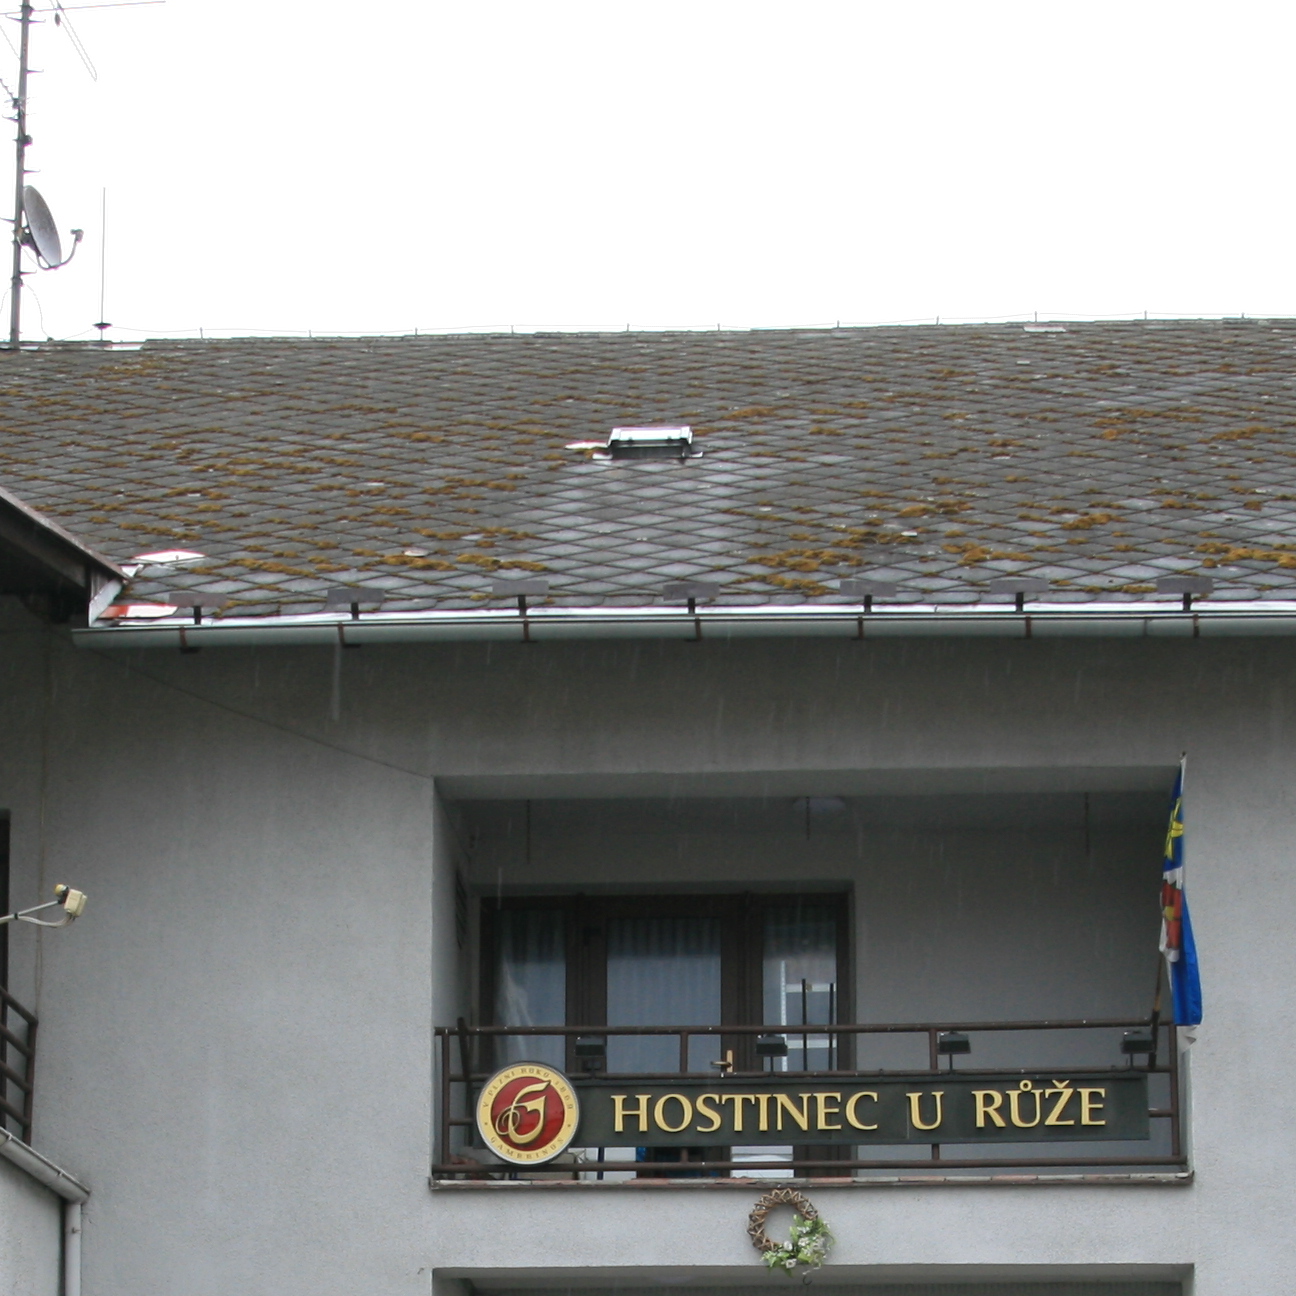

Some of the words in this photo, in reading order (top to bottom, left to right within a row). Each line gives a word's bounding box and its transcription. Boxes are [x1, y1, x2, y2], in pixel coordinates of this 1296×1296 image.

[610, 1091, 879, 1132] HOSTINEC
[905, 1090, 943, 1131] U
[972, 1080, 1107, 1128] RŮŽE
[491, 1136, 564, 1159] GAMBRINUS
